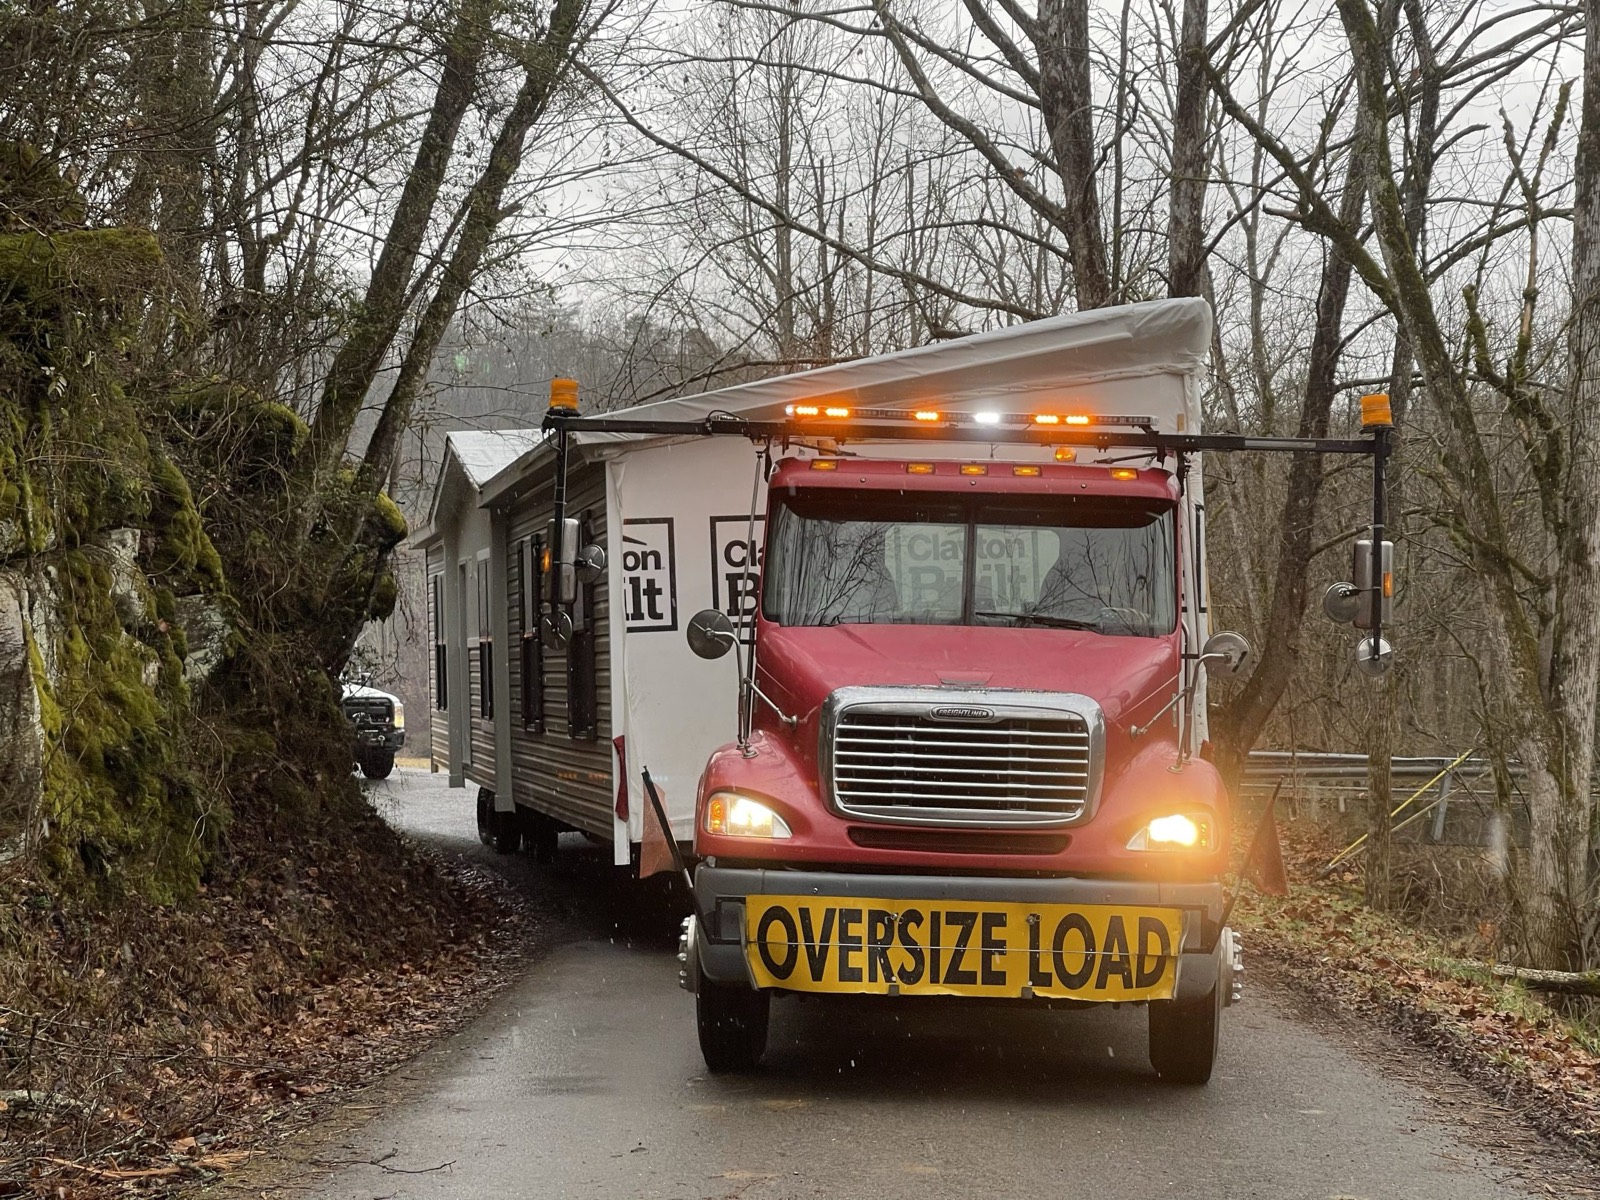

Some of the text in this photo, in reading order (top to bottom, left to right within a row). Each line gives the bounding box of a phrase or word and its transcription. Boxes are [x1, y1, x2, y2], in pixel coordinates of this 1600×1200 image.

[907, 533, 1025, 561] Claton
[939, 708, 987, 717] FREIGHTLINER
[757, 905, 1168, 990] OVERSIZE LOAD
